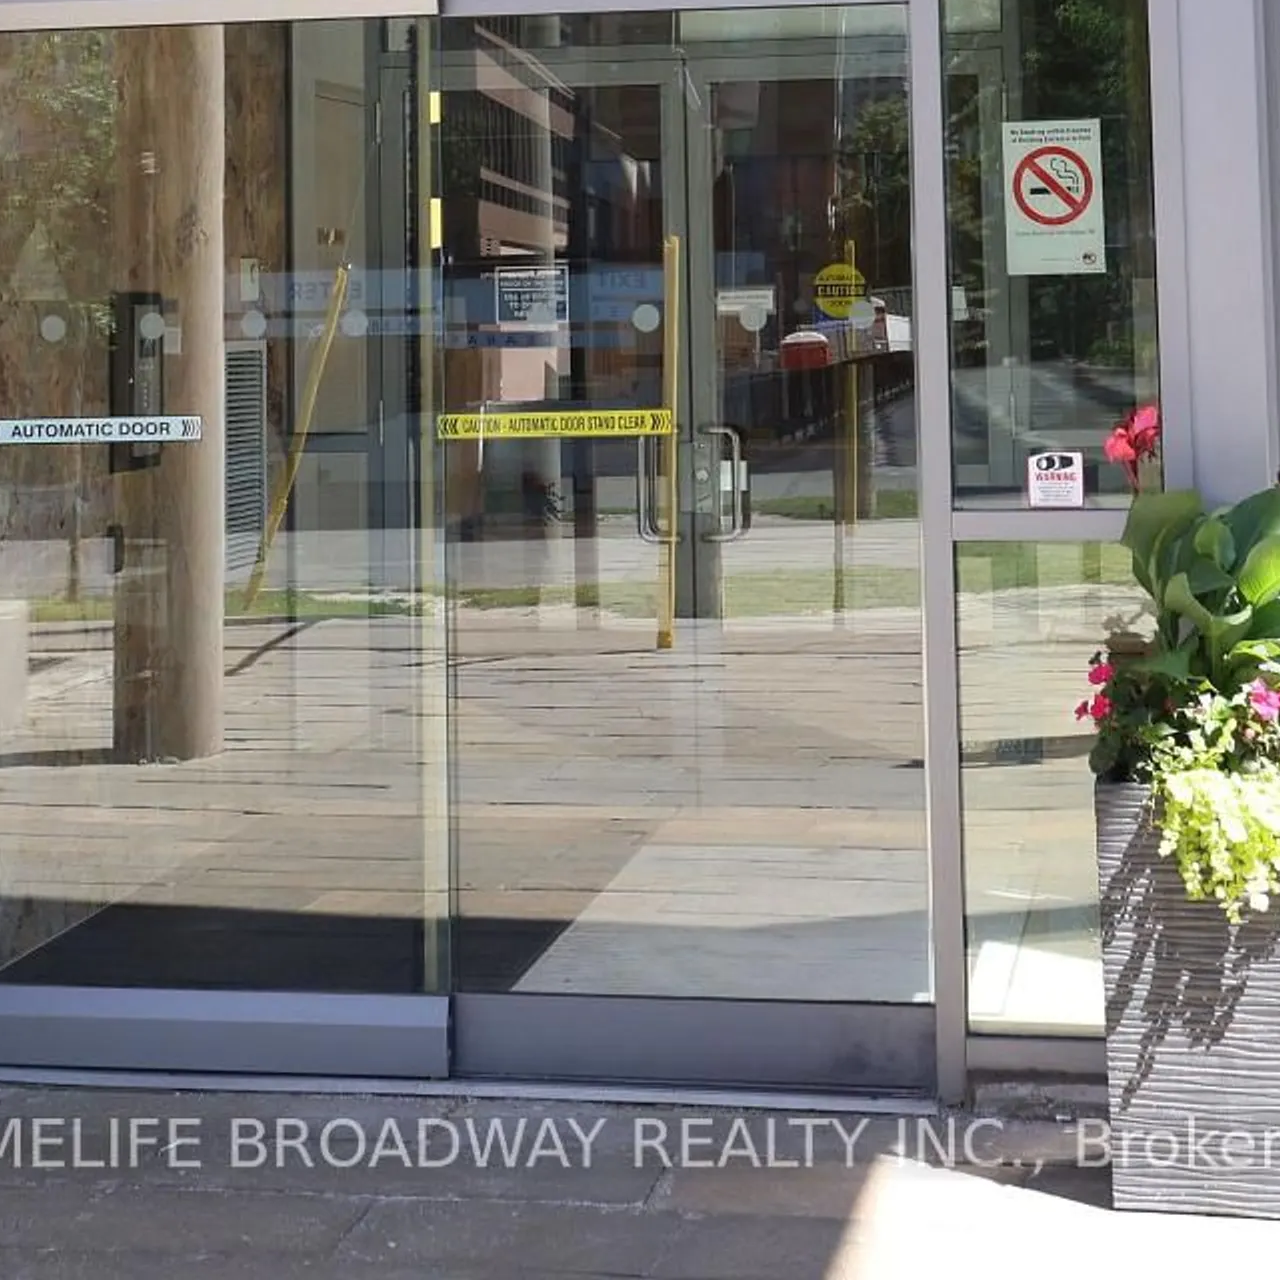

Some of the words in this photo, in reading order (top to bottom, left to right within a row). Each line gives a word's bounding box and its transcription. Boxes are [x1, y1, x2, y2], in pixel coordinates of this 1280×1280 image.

[11, 423, 113, 438] AUTOMATIC
[119, 422, 171, 436] DOOR
[508, 417, 558, 433] AUTOMATIC
[559, 417, 586, 432] DOOR
[587, 416, 616, 431] STAND
[618, 415, 646, 430] CLEAR
